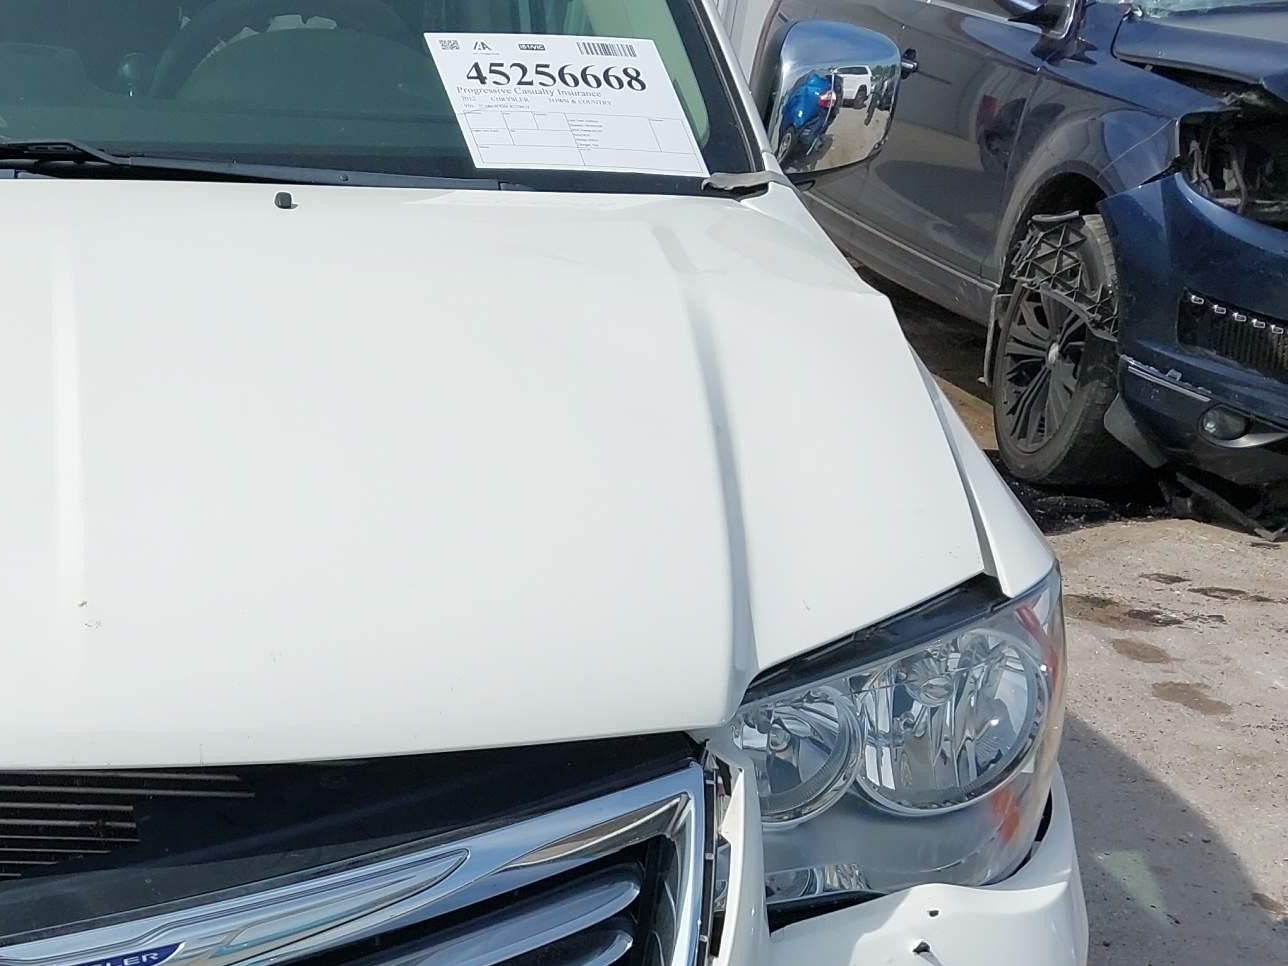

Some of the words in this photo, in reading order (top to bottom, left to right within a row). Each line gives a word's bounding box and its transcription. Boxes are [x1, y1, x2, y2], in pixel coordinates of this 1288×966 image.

[466, 61, 647, 92] 45256668
[457, 86, 512, 97] Progressive
[514, 87, 554, 97] Casualty
[557, 88, 602, 98] Insurance
